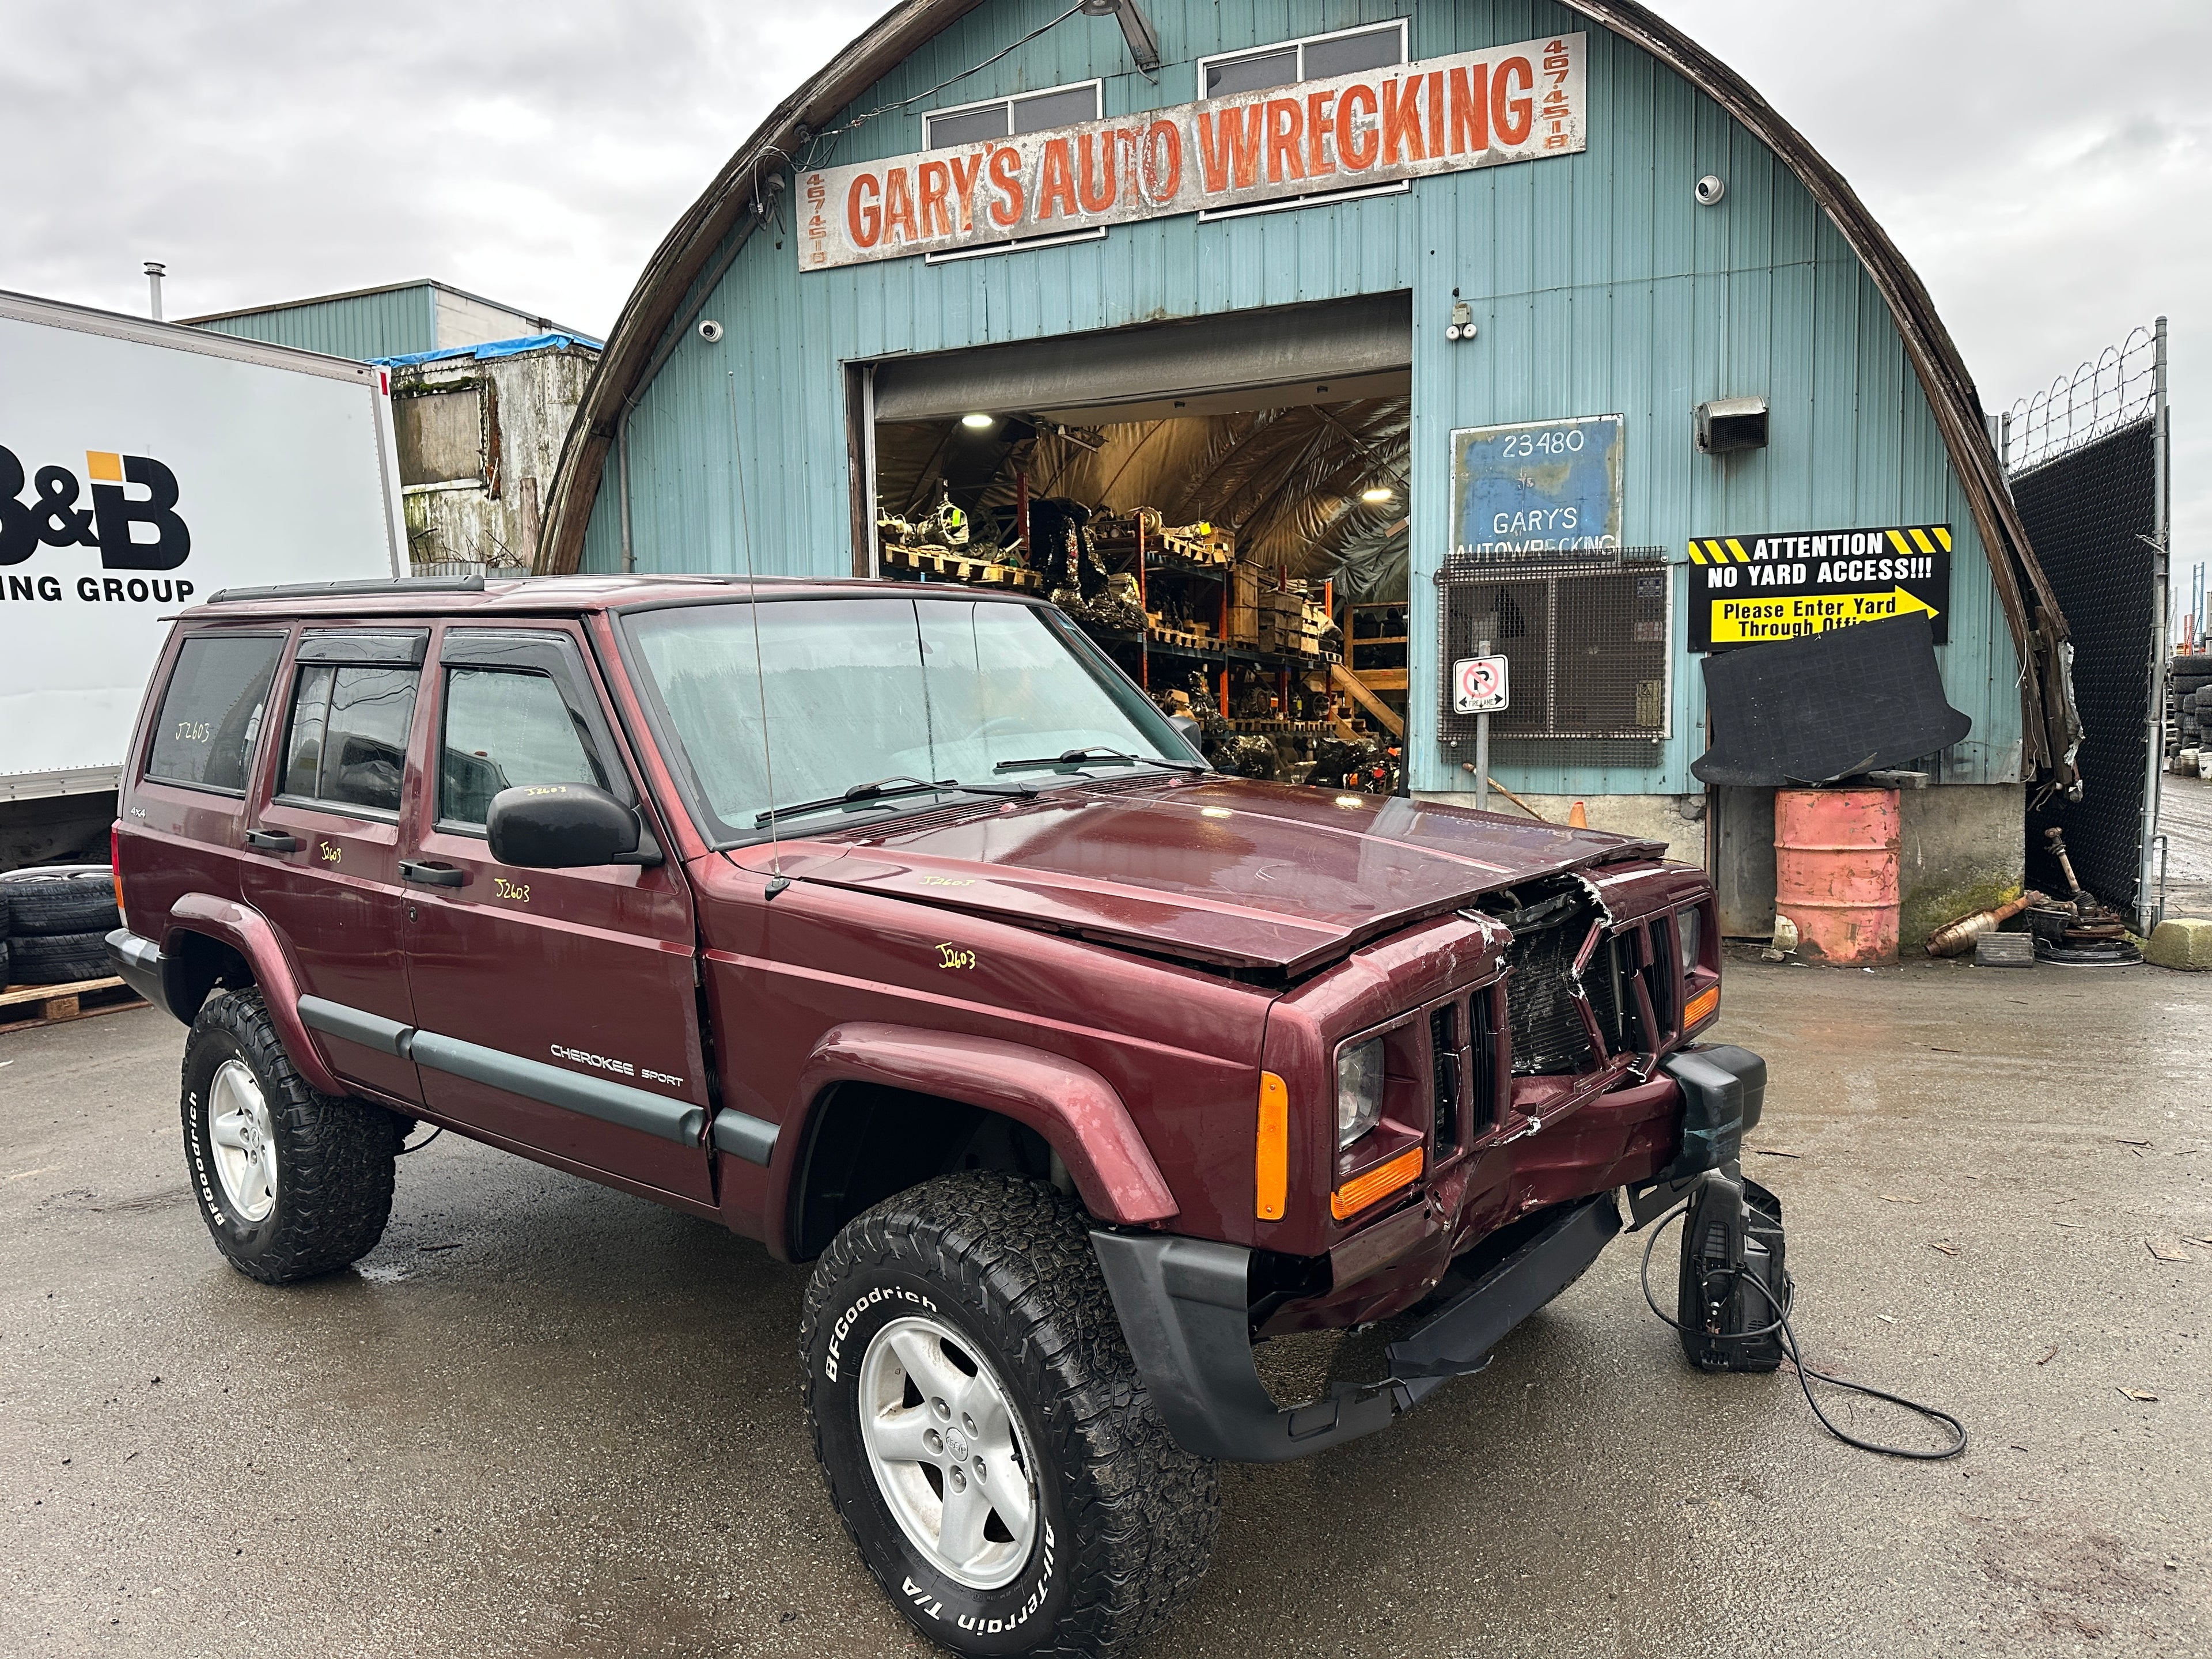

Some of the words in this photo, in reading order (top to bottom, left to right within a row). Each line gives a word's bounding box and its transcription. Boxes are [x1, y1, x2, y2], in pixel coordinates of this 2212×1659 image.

[847, 143, 1024, 248] GARY'S
[1039, 119, 1182, 220] AUTO
[1198, 56, 1533, 194] WRECKING
[1502, 430, 1585, 458] 23480
[1493, 507, 1578, 535] GARY'S
[1753, 532, 1883, 560] ATTENTION
[1707, 566, 1737, 588] NO
[1747, 562, 1807, 586] YARD
[1817, 556, 1932, 583] ACCESS!!!
[77, 577, 194, 603] GROUP
[1724, 603, 1785, 620] Please
[1793, 599, 1844, 617] Enter
[1853, 596, 1896, 615] Yard
[1738, 618, 1813, 638] Through
[176, 722, 210, 743] J2603
[320, 841, 342, 863] J2603
[494, 878, 531, 903] J2603
[934, 941, 976, 969] J2603
[550, 1044, 635, 1077] CHEROKEE
[641, 1069, 684, 1087] SPORT
[188, 1091, 226, 1226] BFGoodrich
[825, 1286, 938, 1383] BFGoodrich
[902, 1575, 943, 1620] T/A
